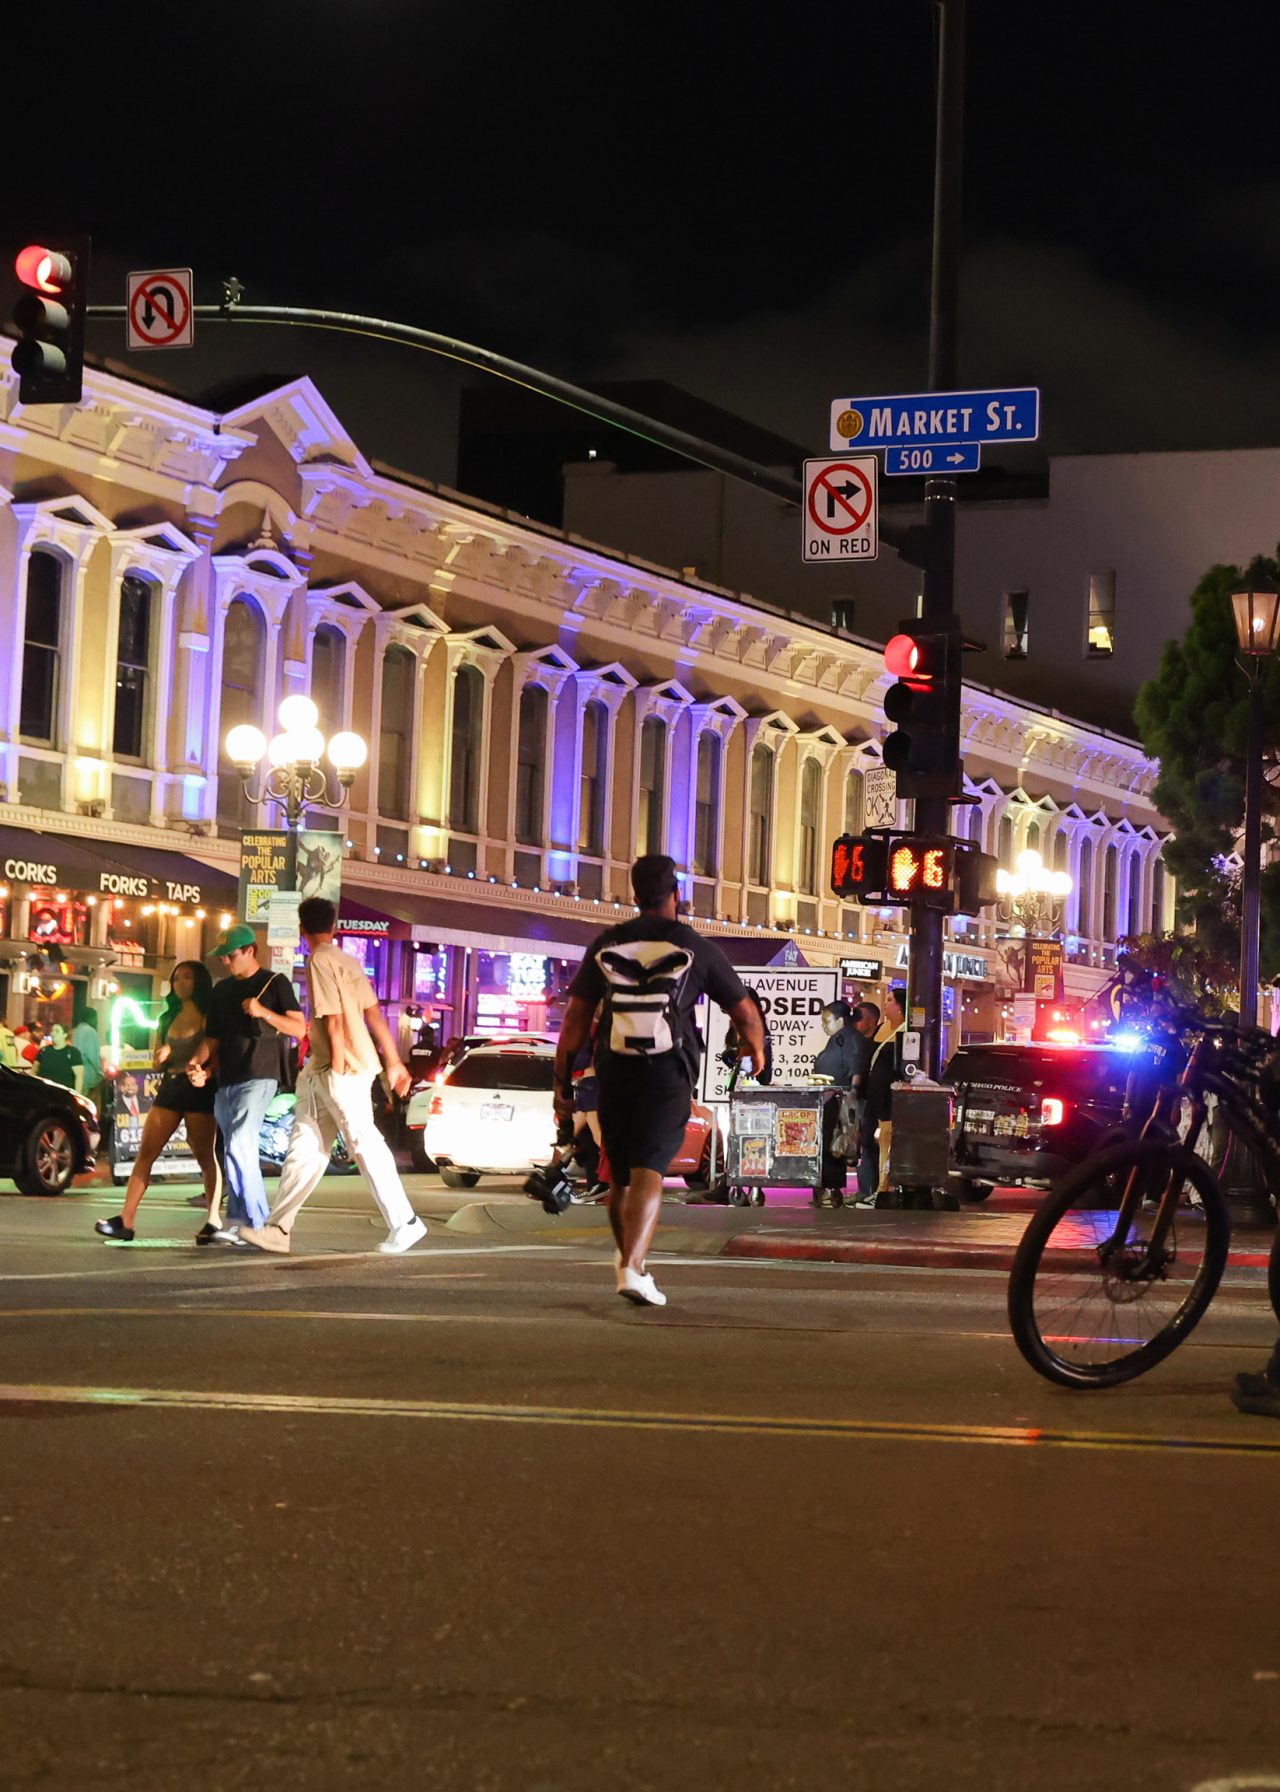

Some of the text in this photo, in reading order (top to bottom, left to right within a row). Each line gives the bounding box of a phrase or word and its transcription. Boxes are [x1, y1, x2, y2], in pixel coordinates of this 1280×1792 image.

[869, 401, 1022, 438] MARKET ST.
[899, 450, 932, 469] 500
[809, 538, 871, 555] ON RED
[867, 771, 896, 783] DIAGONAL
[867, 781, 896, 794] CROSSING
[866, 795, 879, 817] OK
[243, 835, 287, 847] CELEBRATING
[257, 846, 272, 856] THE
[242, 856, 286, 870] POPULAR
[923, 849, 943, 887] 6
[4, 859, 201, 904] CORKS FORKS TAPS
[250, 869, 277, 884] ARTS
[337, 920, 390, 932] TUESDAY
[785, 950, 799, 962] FAT
[1032, 955, 1060, 965] POPULAR
[841, 959, 878, 970] AMERICAN
[1037, 965, 1054, 974] ARTS
[756, 978, 818, 991] AVENUE
[760, 996, 825, 1016] OSED
[788, 1034, 806, 1046] ST
[778, 1054, 789, 1064] 3,
[993, 1084, 1023, 1092] POLICE
